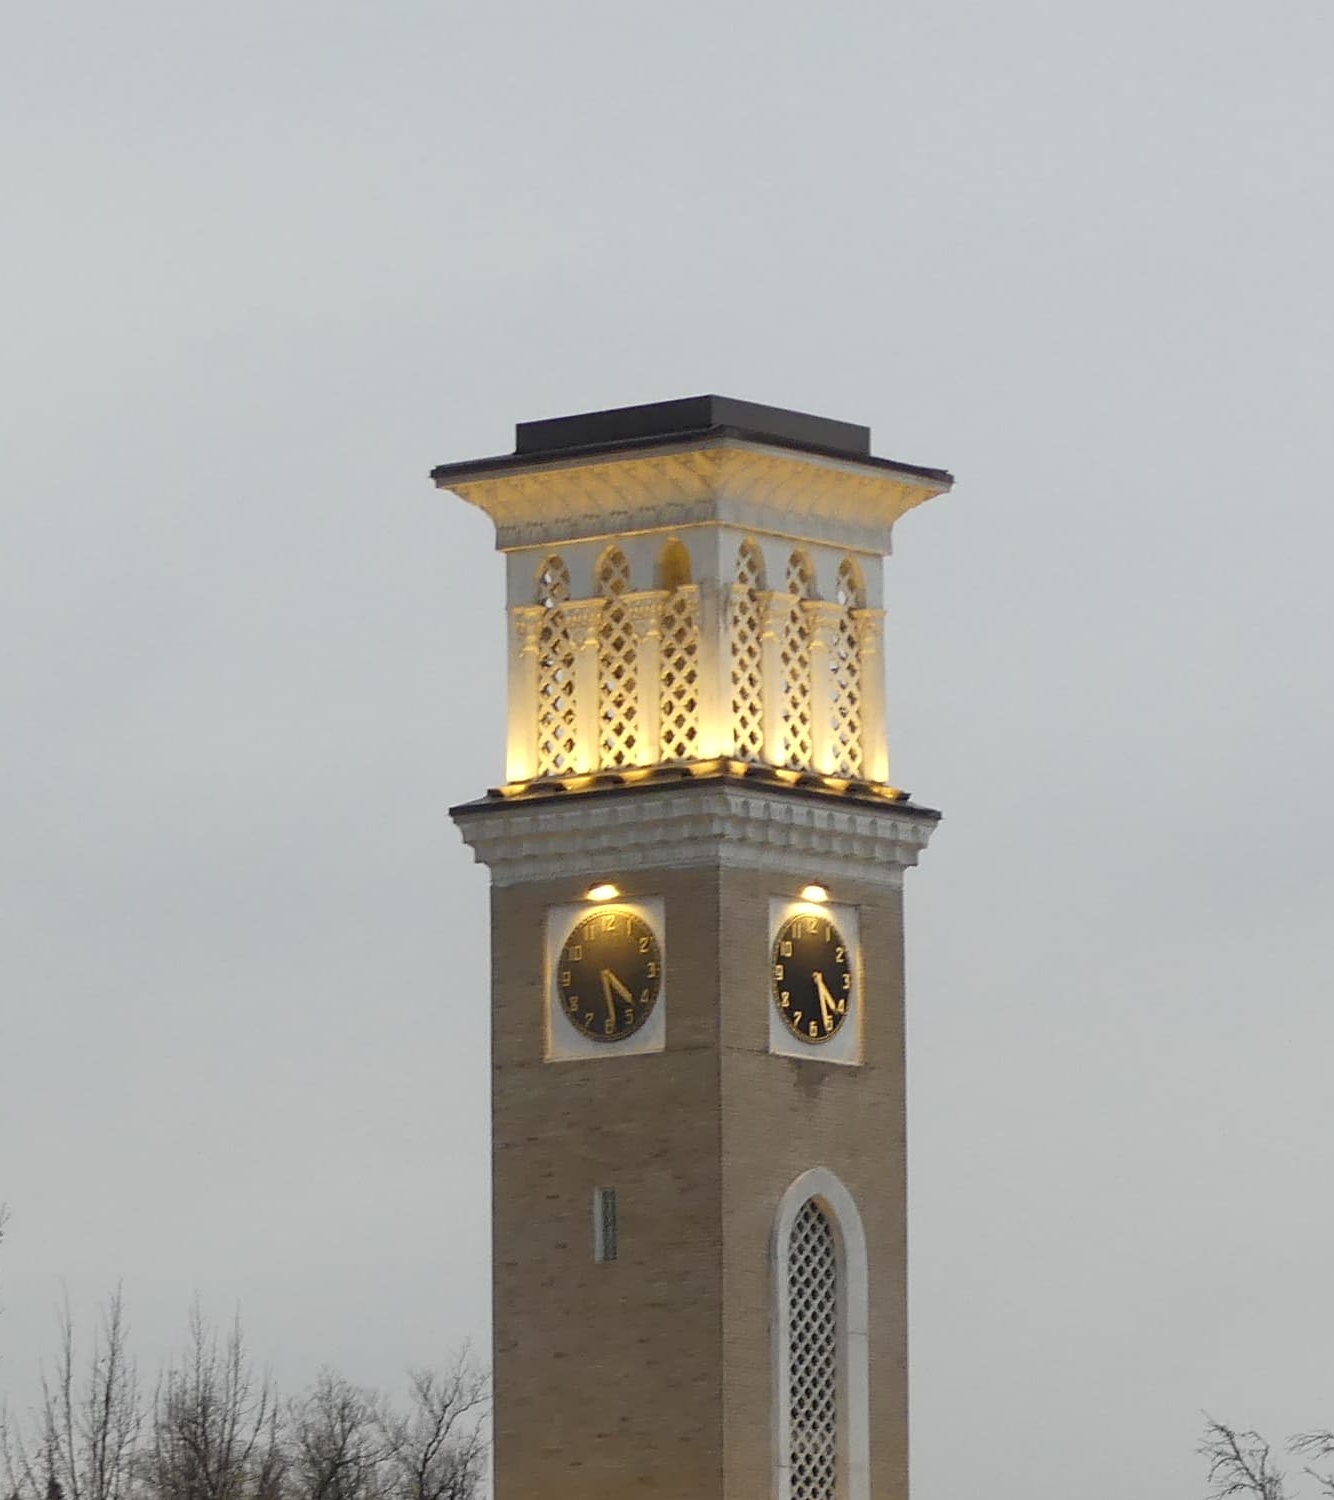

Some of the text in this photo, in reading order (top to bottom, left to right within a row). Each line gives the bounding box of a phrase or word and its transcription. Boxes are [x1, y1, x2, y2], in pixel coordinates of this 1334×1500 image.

[639, 936, 650, 953] 2
[780, 941, 792, 957] 10
[835, 946, 844, 963] 2
[647, 962, 658, 978] 3
[775, 964, 784, 980] 9
[842, 973, 851, 989] 3
[640, 988, 651, 1003] 4
[781, 991, 790, 1007] 8
[837, 998, 845, 1014] 4
[585, 1012, 595, 1028] 7
[625, 1008, 634, 1024] 5
[793, 1011, 802, 1027] 7
[809, 1020, 818, 1037] 6
